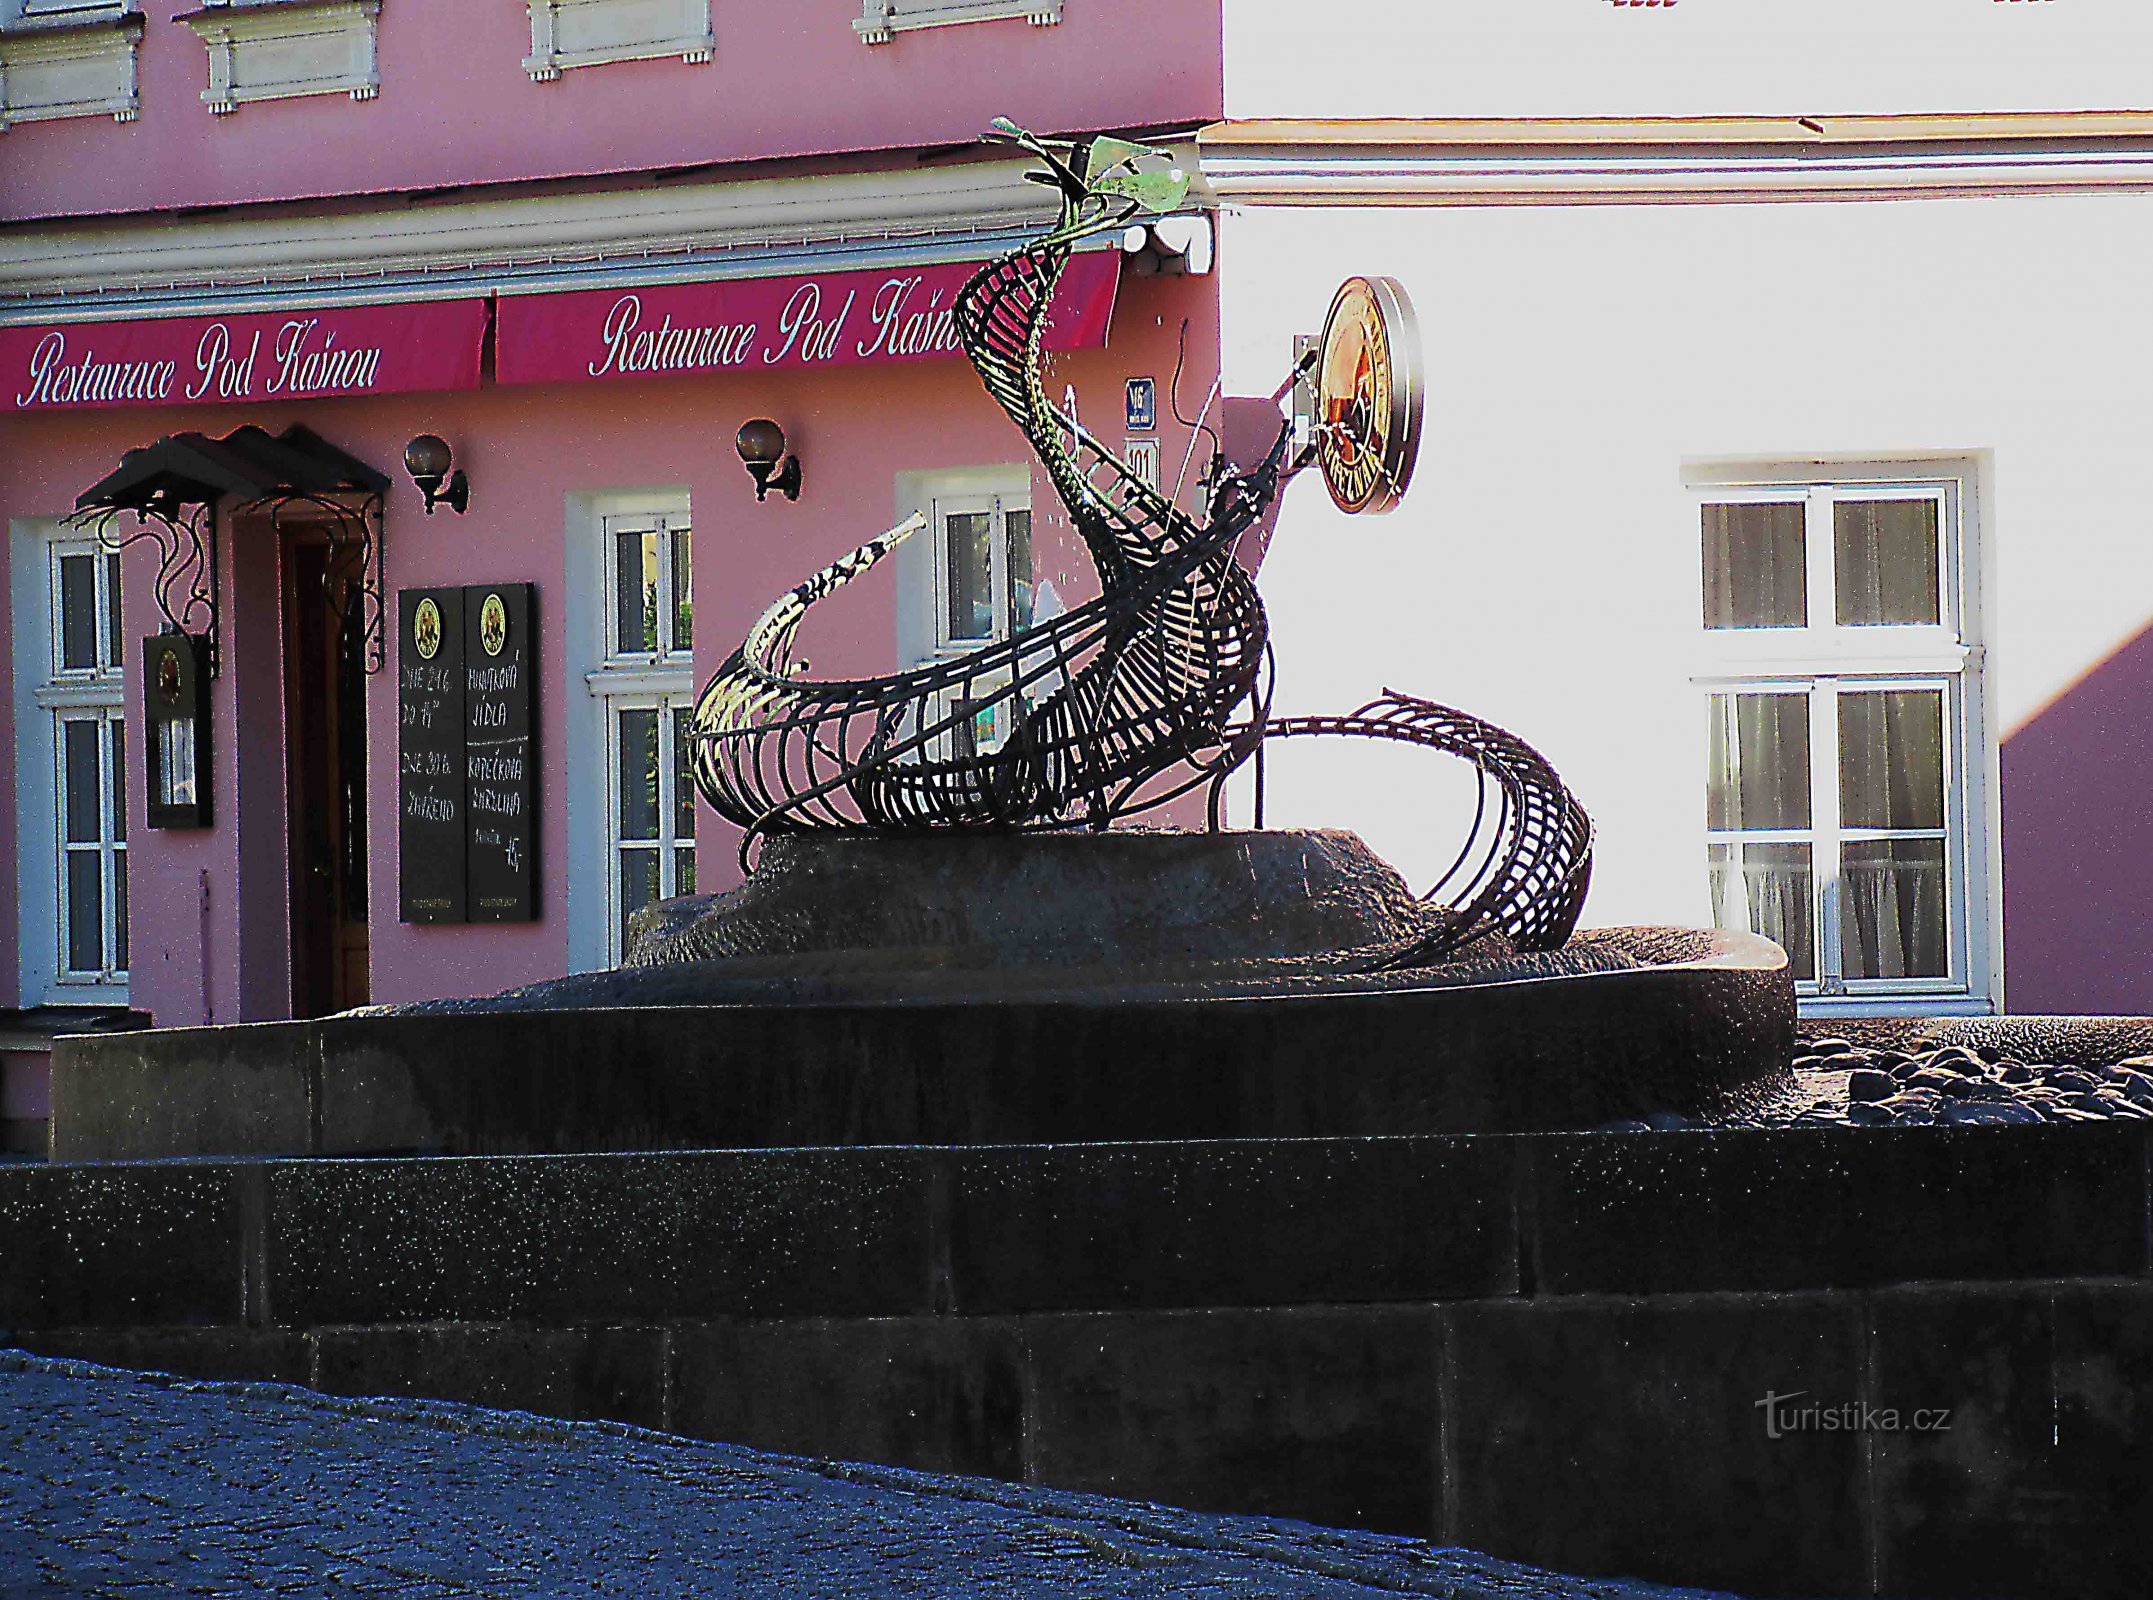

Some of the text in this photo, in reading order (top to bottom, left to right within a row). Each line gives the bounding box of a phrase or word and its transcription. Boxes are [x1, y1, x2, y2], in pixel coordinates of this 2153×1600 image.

[588, 295, 756, 376] Restaurace
[763, 282, 855, 364] Pod
[16, 318, 380, 407] Restaurace Pod Kašnou
[472, 694, 507, 727] JÍDLA
[468, 745, 523, 781] KOPEČKOVÁ
